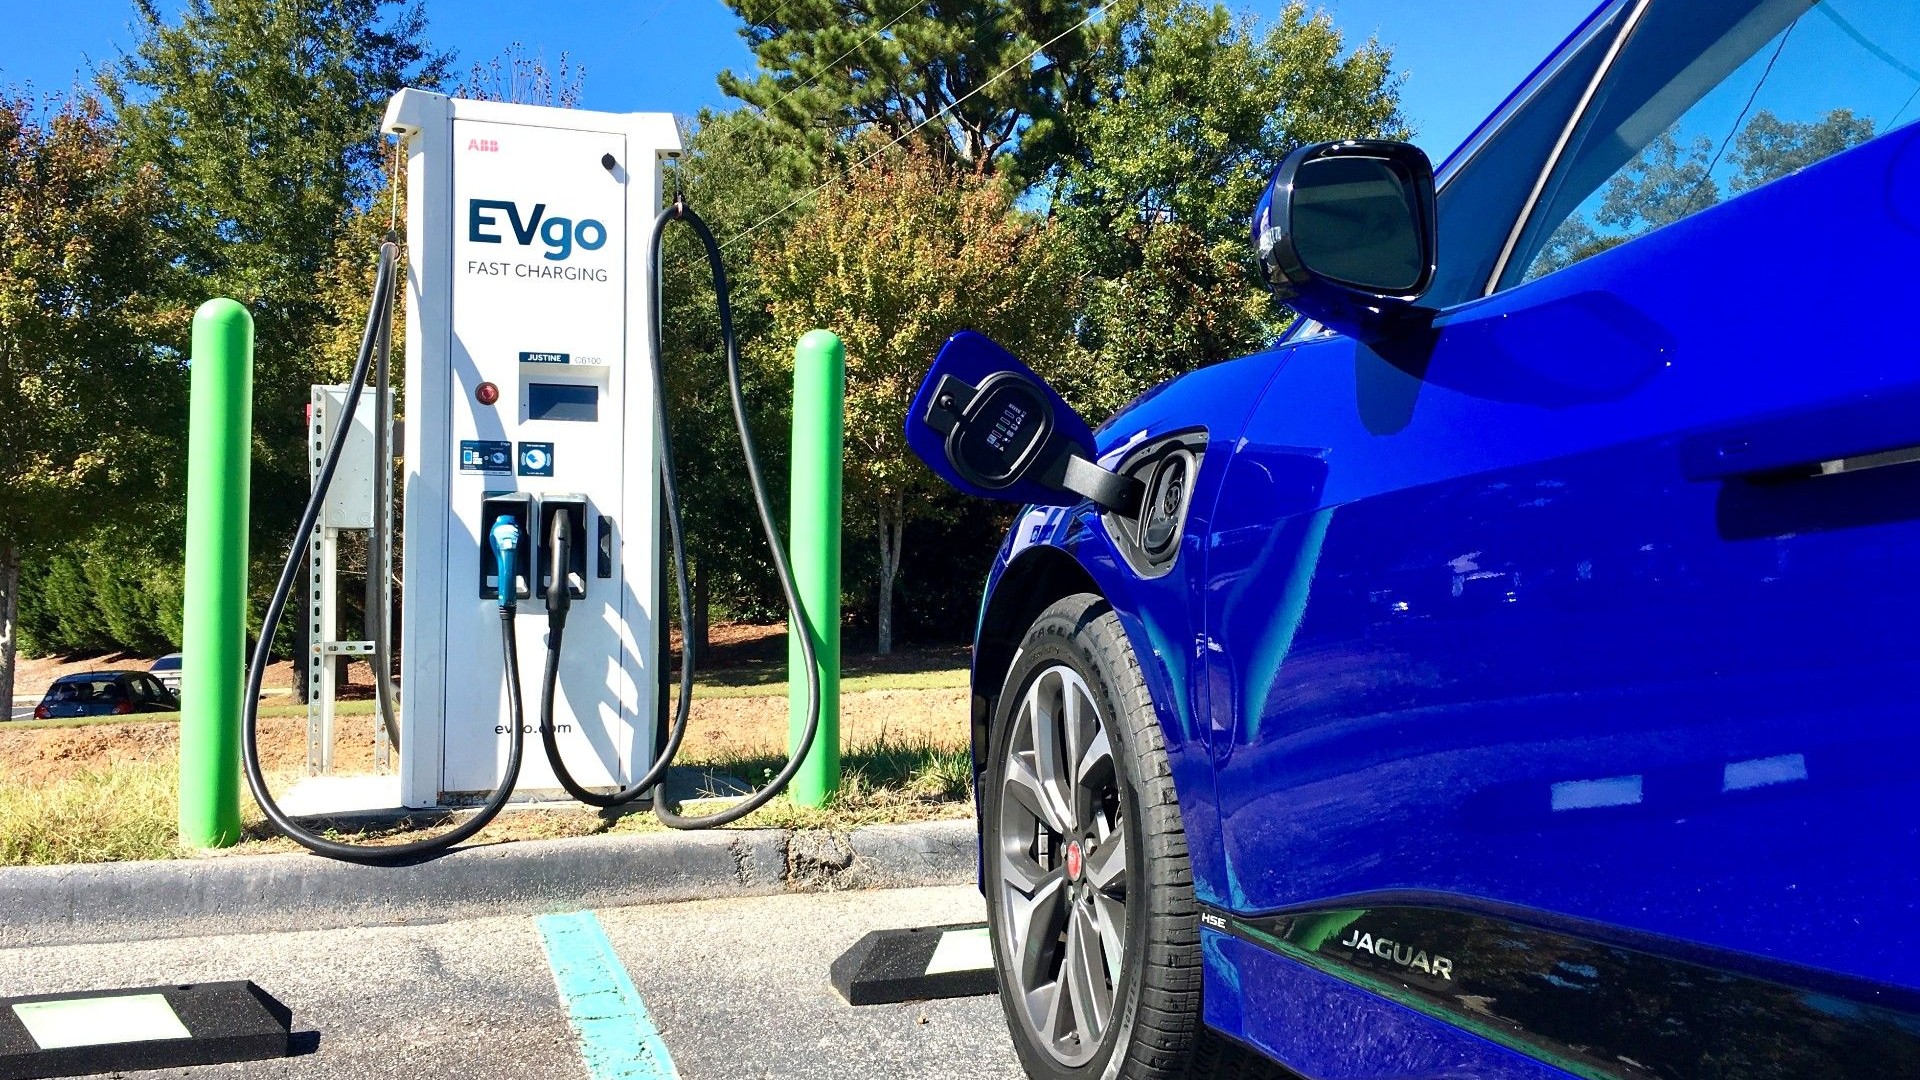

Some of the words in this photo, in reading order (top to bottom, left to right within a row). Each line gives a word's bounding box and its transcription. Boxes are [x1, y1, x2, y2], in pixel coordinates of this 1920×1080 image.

[468, 139, 499, 152] ABB
[468, 198, 608, 261] EVgo
[468, 261, 511, 276] FAST
[515, 264, 608, 282] CHARGING
[527, 354, 562, 362] JUSTINE
[575, 356, 602, 365] C6100
[1202, 912, 1226, 929] HSE
[1342, 929, 1453, 981] JAGUAR
